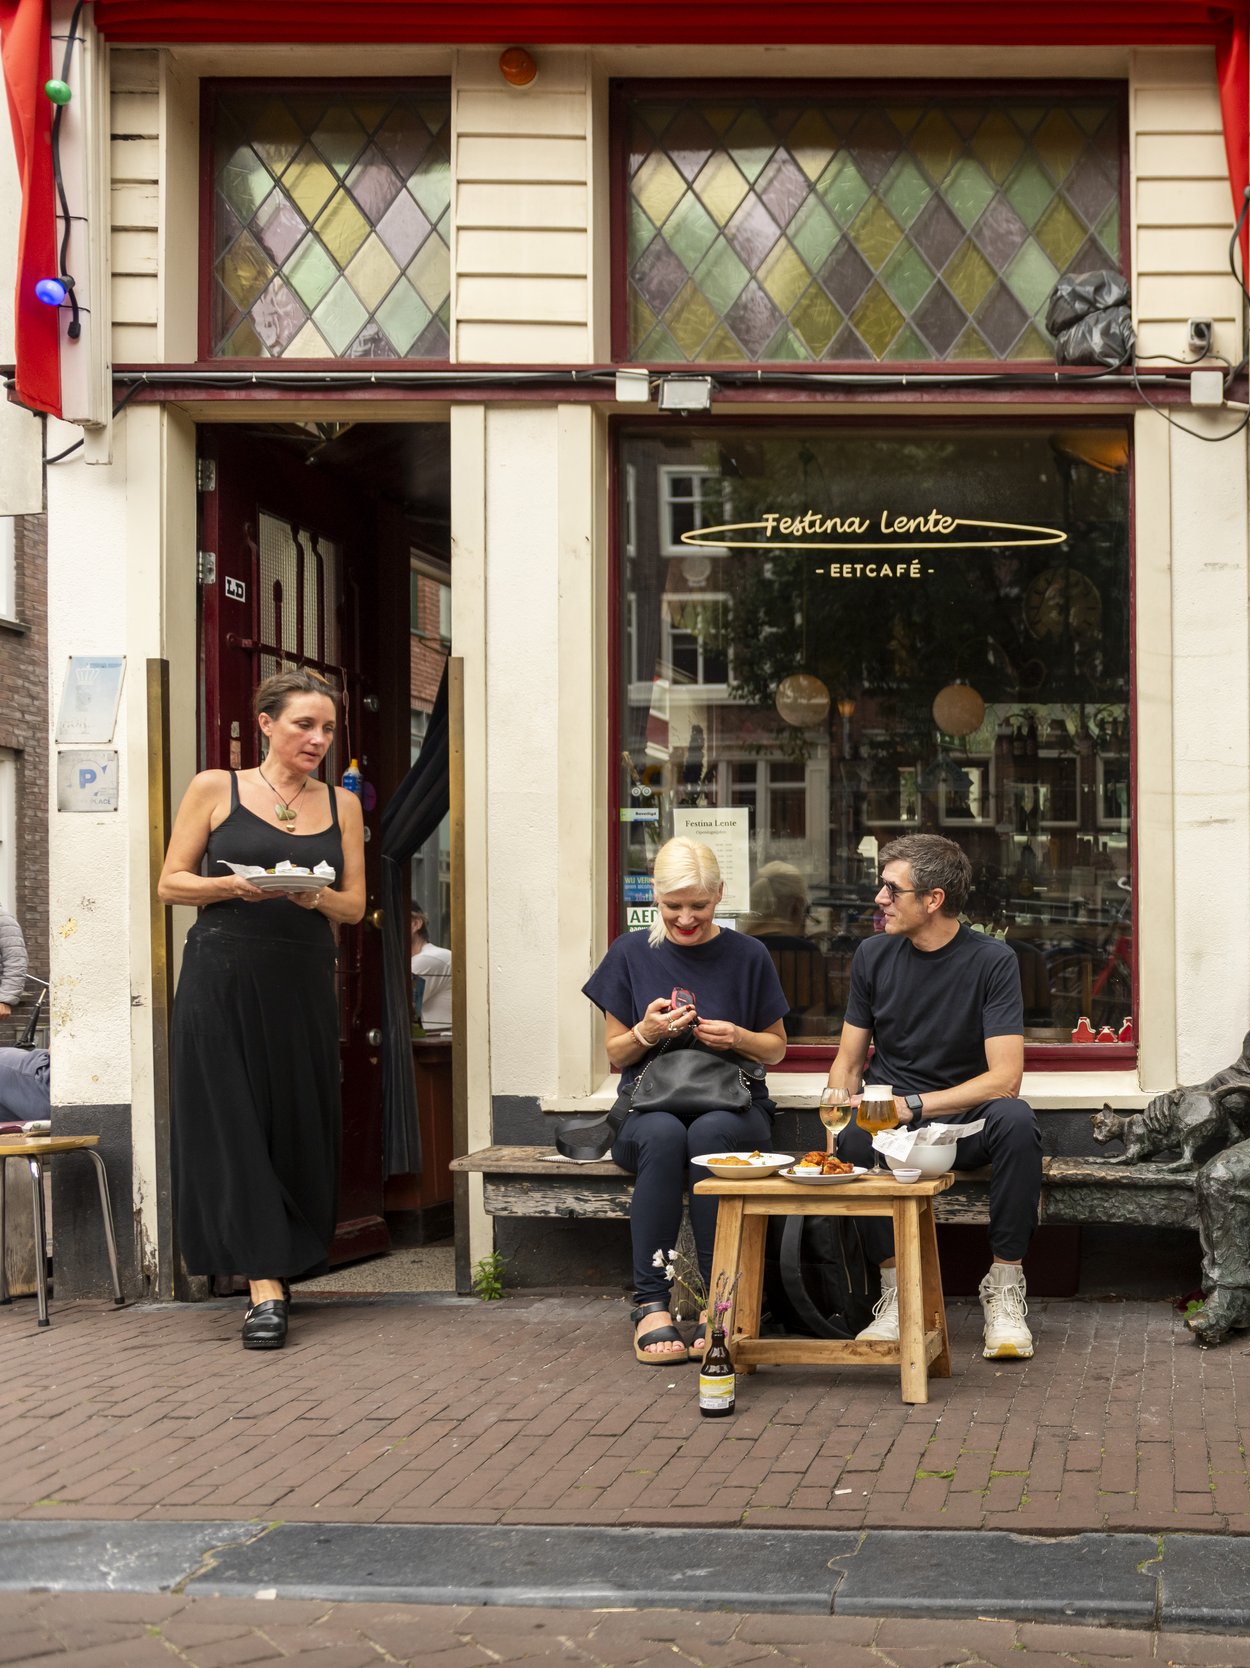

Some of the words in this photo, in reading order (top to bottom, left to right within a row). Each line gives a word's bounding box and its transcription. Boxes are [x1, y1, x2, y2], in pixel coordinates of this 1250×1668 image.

[762, 510, 869, 537] Festina
[880, 508, 958, 534] Lente
[830, 559, 921, 578] EETCAFÉ
[714, 819, 737, 827] Lente
